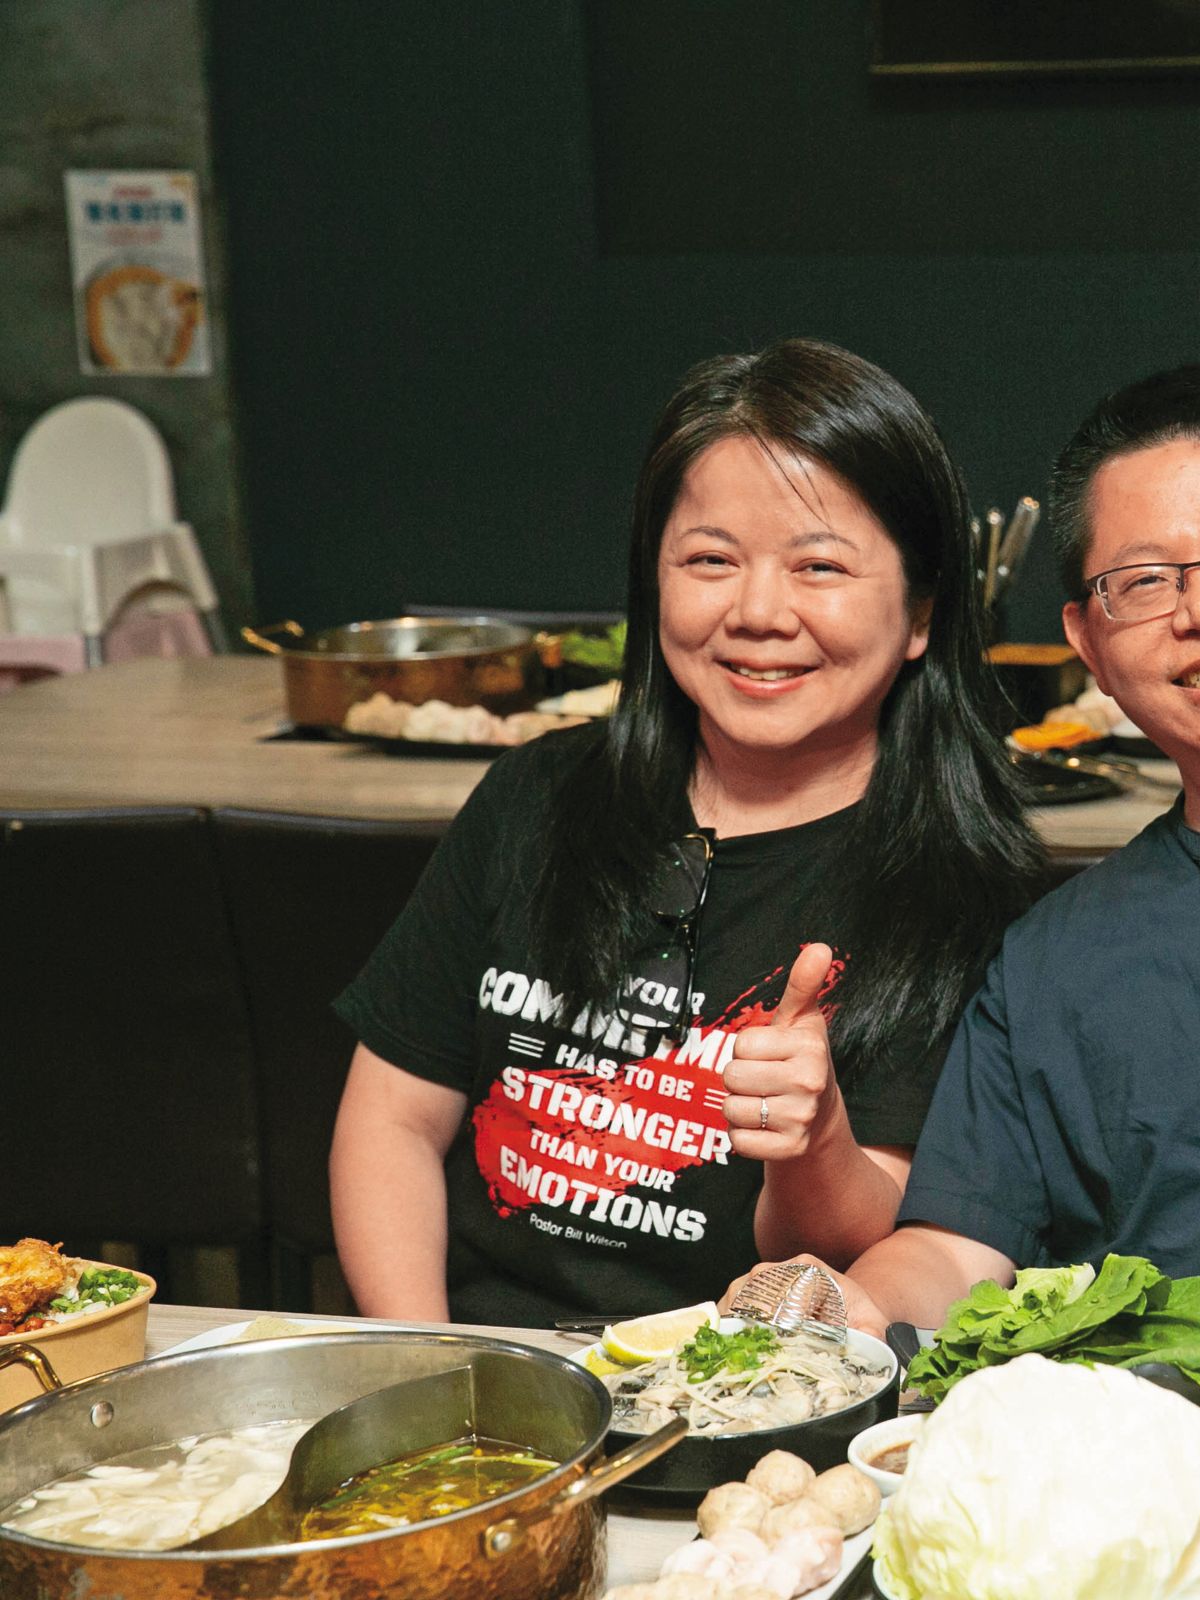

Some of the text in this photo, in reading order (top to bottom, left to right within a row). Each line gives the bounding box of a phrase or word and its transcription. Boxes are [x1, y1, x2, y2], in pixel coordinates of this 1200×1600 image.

[623, 974, 706, 1015] YOUR
[555, 1043, 696, 1102] HAS TO BE
[501, 1066, 733, 1166] STRONGER
[530, 1128, 677, 1193] THAN YOUR
[500, 1144, 707, 1243] EMOTIONS
[529, 1212, 627, 1249] Pastor Bill Wilson
